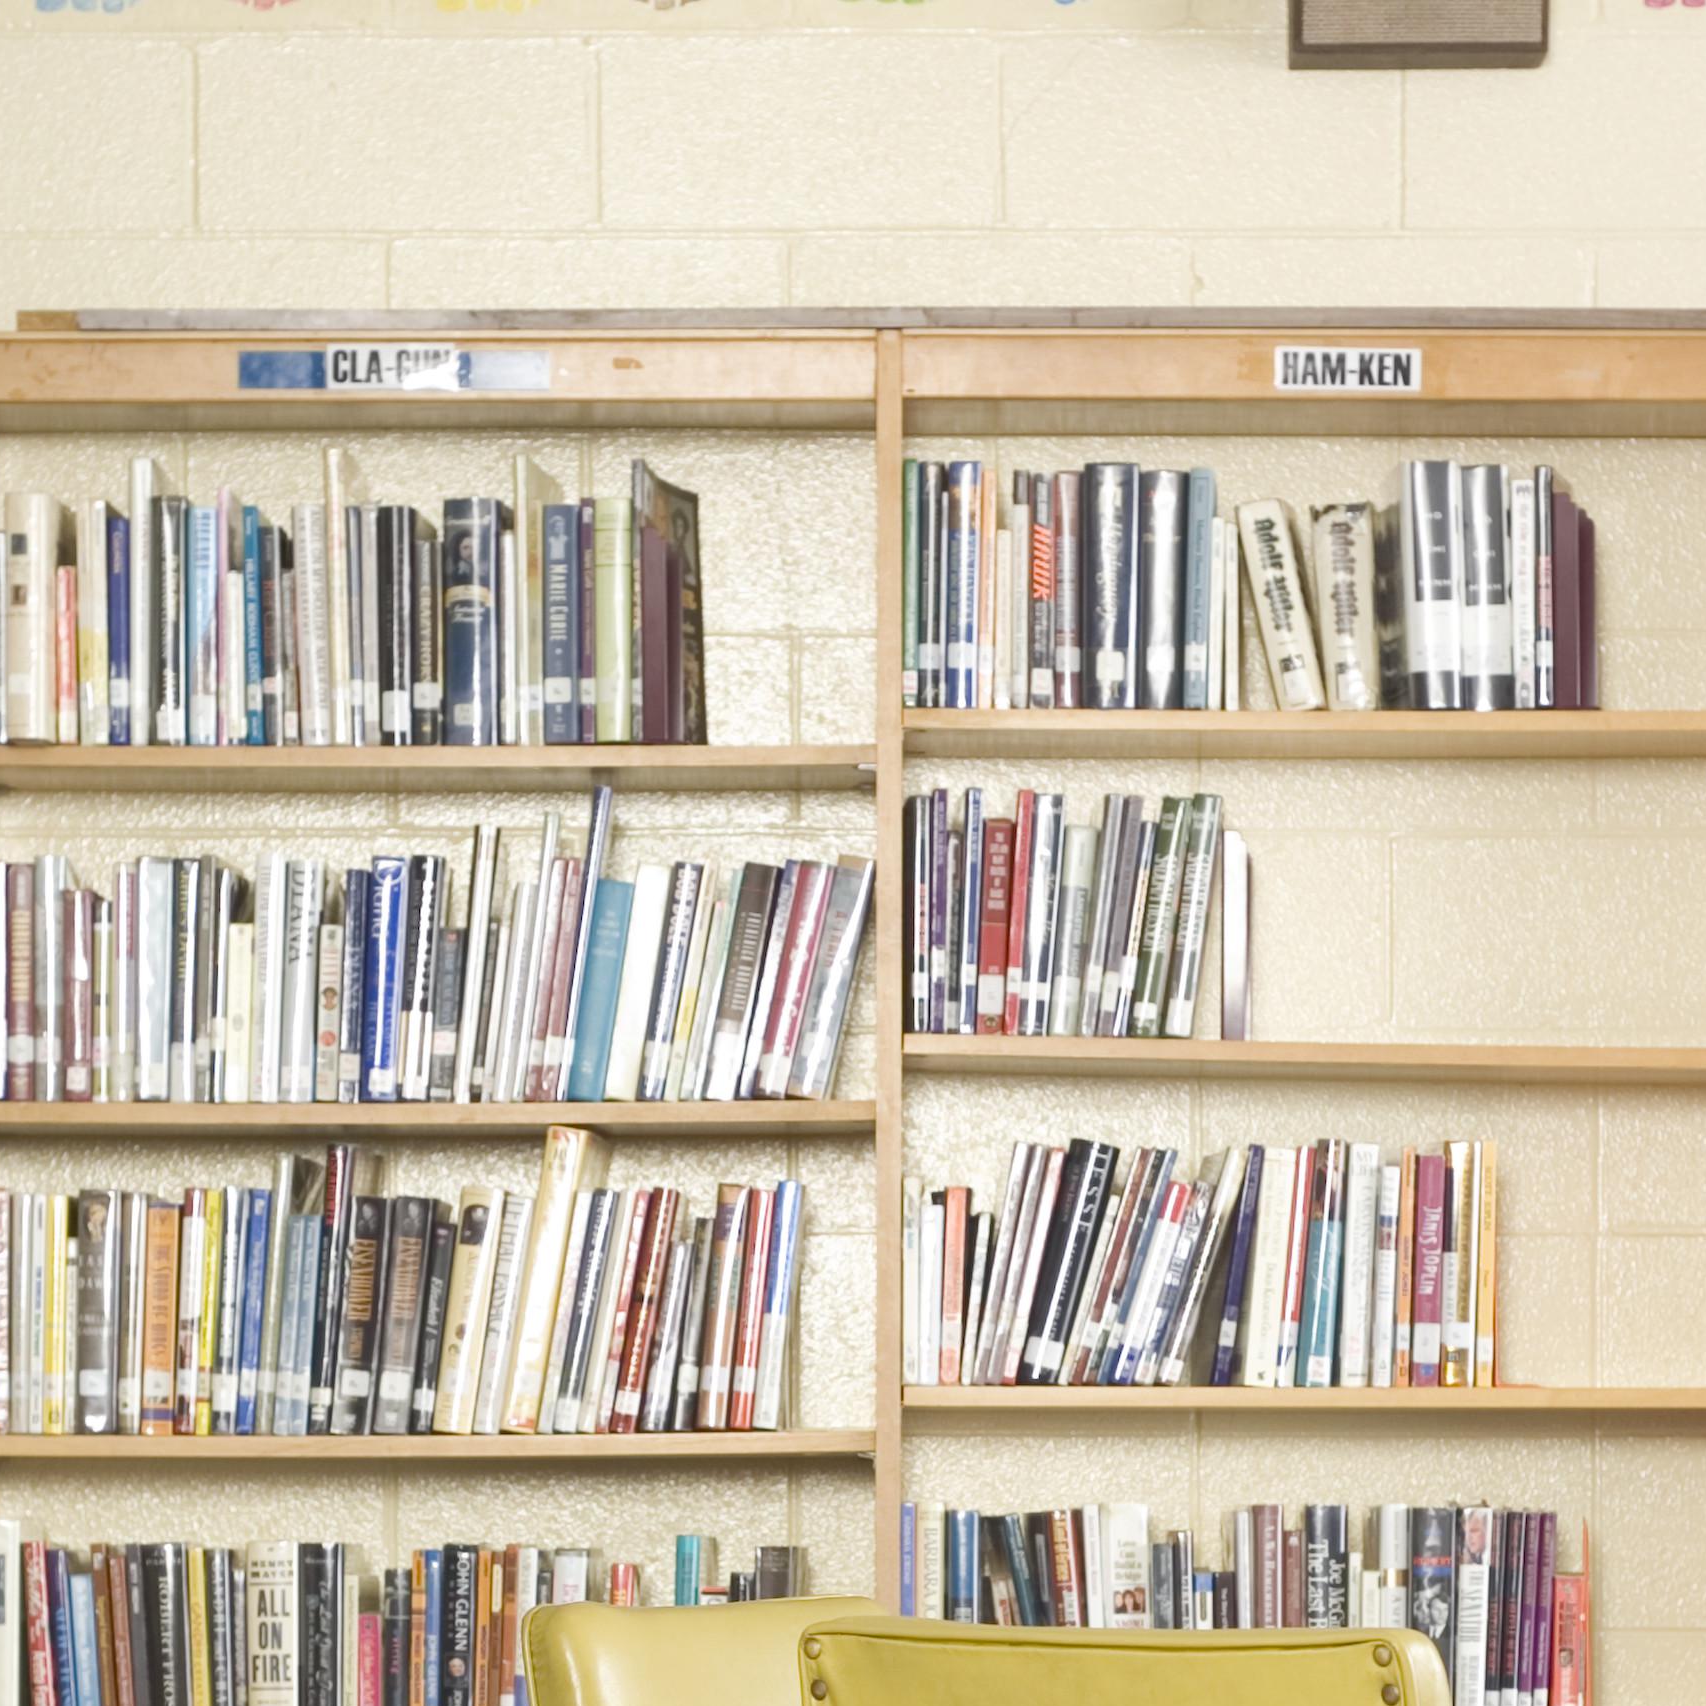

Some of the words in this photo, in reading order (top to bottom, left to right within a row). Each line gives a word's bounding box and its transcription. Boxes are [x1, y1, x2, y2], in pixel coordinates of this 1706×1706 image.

[1282, 351, 1412, 386] HAM-KEN
[548, 564, 568, 602] MARIE
[548, 606, 569, 641] CURIE
[1418, 1206, 1442, 1244] JANIS
[347, 1239, 377, 1320] EISENHOWER
[1418, 1248, 1441, 1295] JOPLIN
[455, 1552, 470, 1595] JOHN
[923, 1528, 938, 1596] BARBARA
[1307, 1539, 1326, 1574] The
[1328, 1560, 1345, 1584] Joe
[257, 1590, 290, 1617] ALL
[1307, 1577, 1326, 1614] Last
[157, 1575, 175, 1663] ROBERT
[454, 1599, 468, 1651] GLENN
[1460, 1589, 1483, 1643] SENATOR
[259, 1622, 283, 1650] ON
[252, 1654, 291, 1682] FIRE
